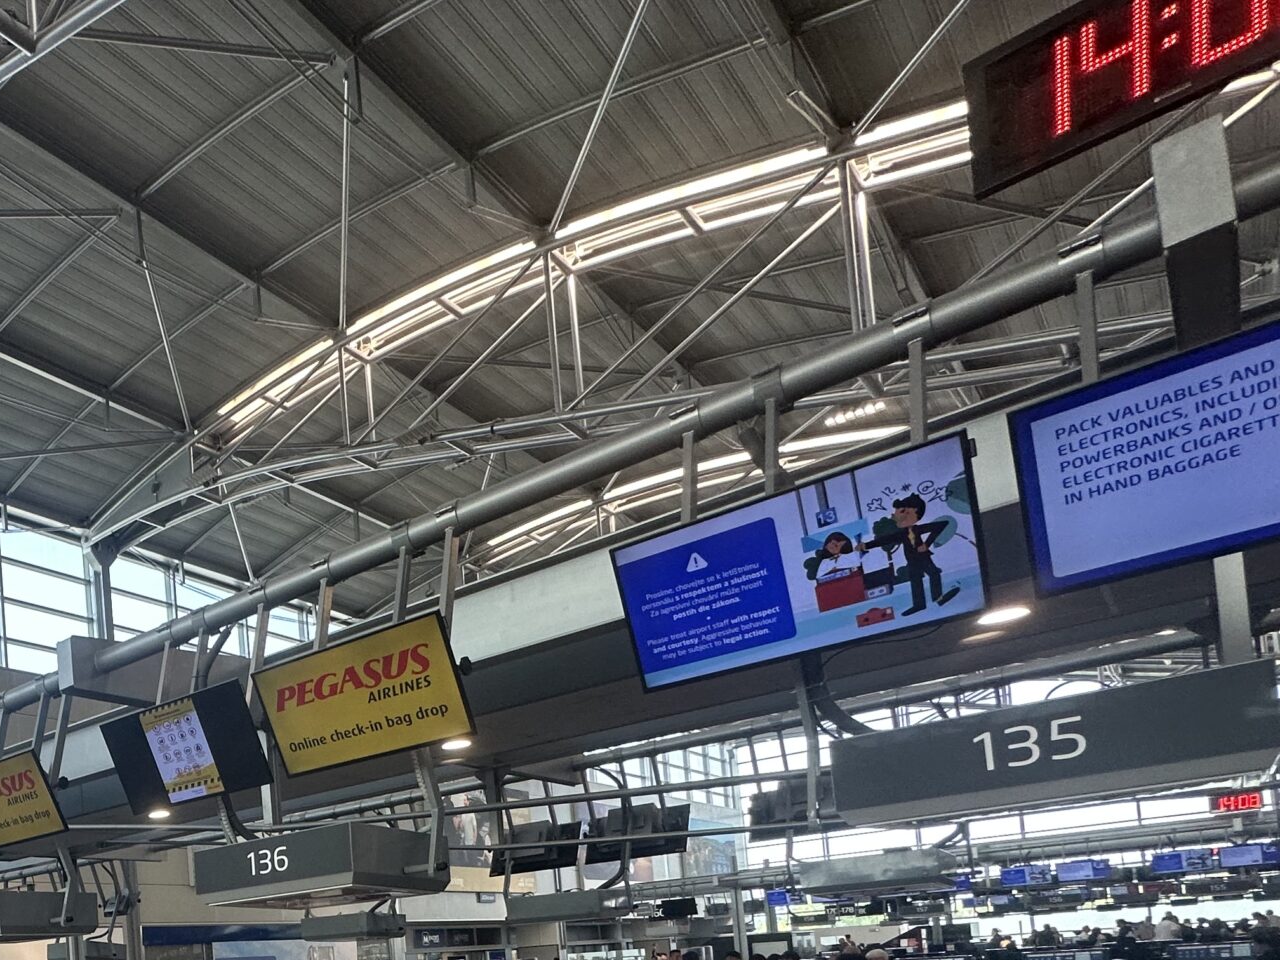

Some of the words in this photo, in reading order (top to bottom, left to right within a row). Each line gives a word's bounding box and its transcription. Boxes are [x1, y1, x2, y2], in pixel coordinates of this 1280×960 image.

[1055, 415, 1103, 440] PACK
[1108, 375, 1223, 423] VALUABLES
[1229, 359, 1275, 385] AND
[1057, 407, 1188, 457] ELECTRONICS,
[1195, 374, 1280, 414] INCLUDI
[1060, 423, 1193, 473] POWERBANKS
[1198, 407, 1242, 432] AND
[1263, 395, 1280, 411] O
[1062, 445, 1176, 490] ELECTRONIC
[1064, 490, 1083, 506] IN
[1088, 473, 1142, 499] HAND
[1148, 444, 1242, 482] BAGGAGE
[818, 511, 836, 524] 13
[681, 583, 722, 600] respektem
[730, 613, 749, 625] with
[750, 606, 780, 620] respect
[653, 645, 666, 654] and
[723, 633, 742, 646] legal
[276, 643, 431, 713] PEGASUS
[367, 674, 432, 704] AIRLINES
[289, 735, 327, 753] Online
[330, 720, 383, 742] check-in
[385, 715, 413, 731] bag
[416, 703, 449, 723] drop
[972, 714, 1088, 772] 135
[7, 790, 39, 806] AIRLINES
[19, 813, 34, 825] bag
[34, 809, 51, 821] drop
[246, 846, 289, 877] 136
